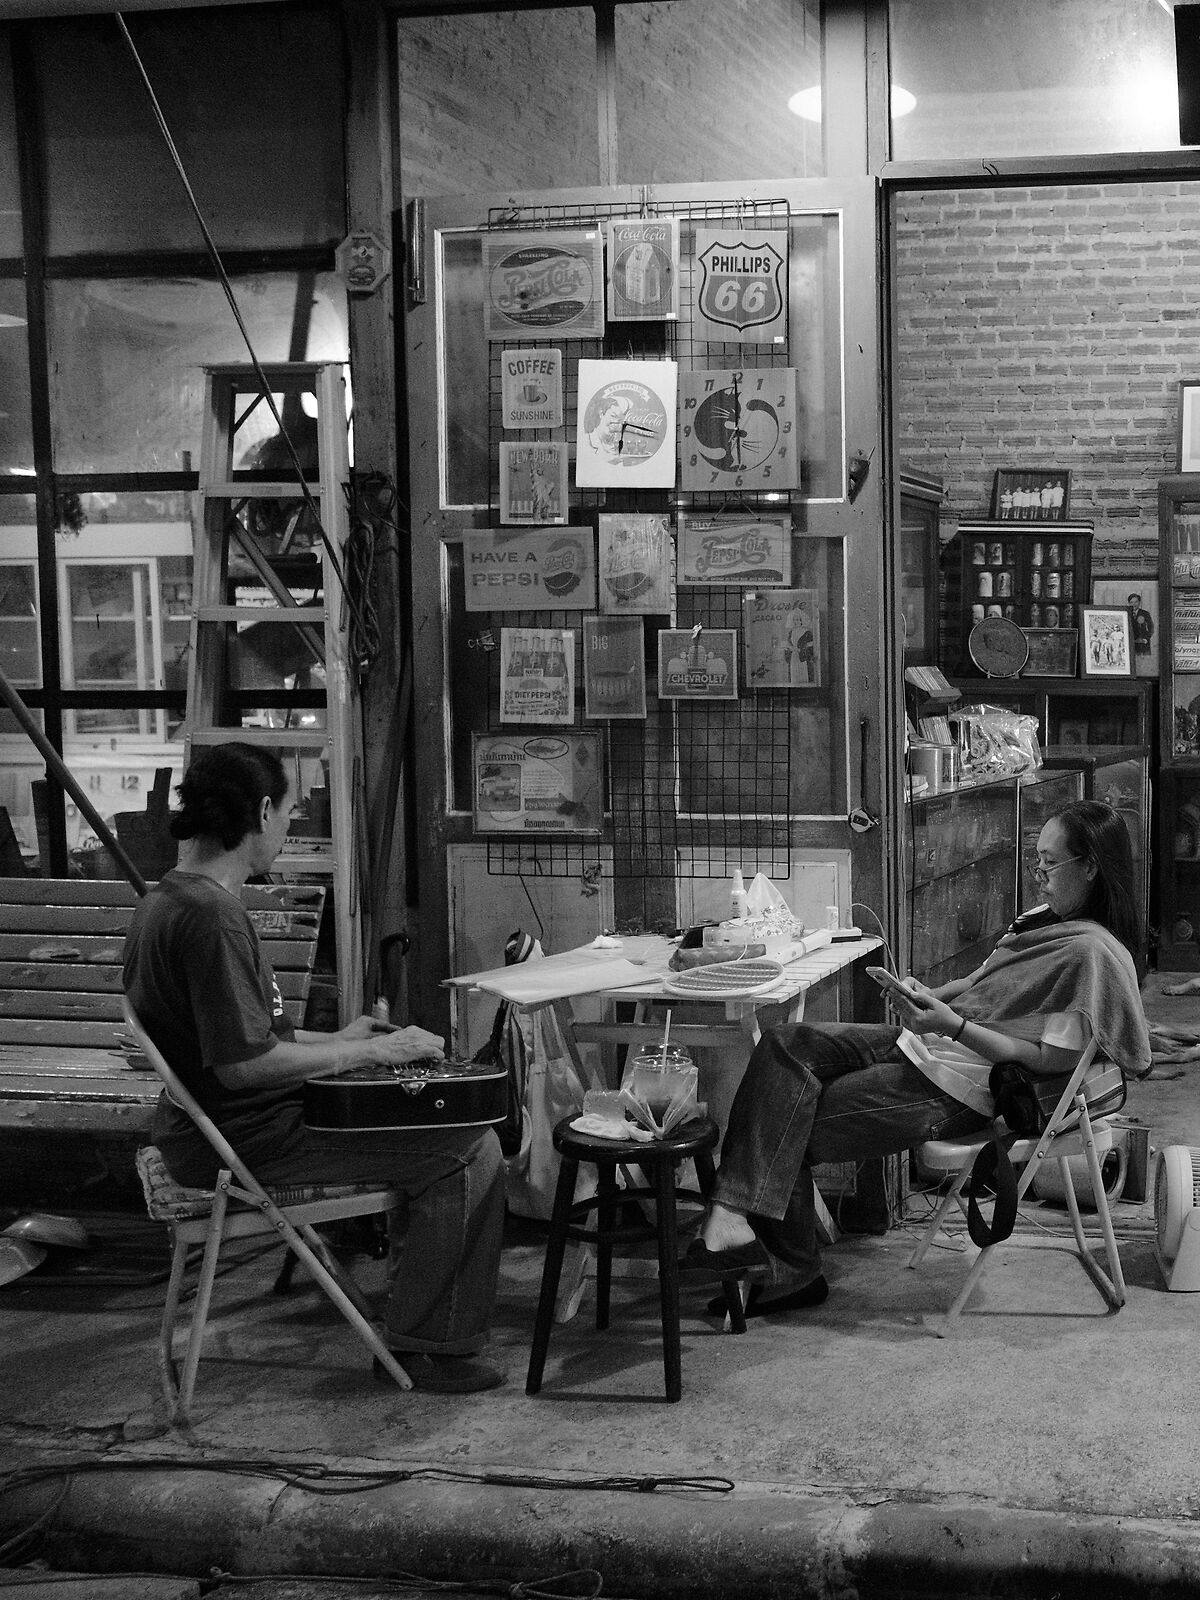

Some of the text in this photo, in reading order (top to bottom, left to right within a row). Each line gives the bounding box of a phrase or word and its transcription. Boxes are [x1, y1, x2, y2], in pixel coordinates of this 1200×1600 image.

[712, 256, 771, 273] PHILLIPS
[714, 280, 768, 313] 66
[508, 359, 555, 376] COFFEE
[704, 379, 715, 391] 11
[757, 378, 764, 391] 1
[684, 398, 697, 409] 10
[777, 395, 786, 408] 2
[510, 410, 554, 421] SUNSHINE
[683, 425, 692, 437] 9
[782, 421, 792, 434] 3
[778, 447, 787, 458] 4
[690, 454, 698, 467] 8
[710, 471, 719, 483] 7
[762, 465, 772, 478] 5
[735, 475, 743, 487] 6
[471, 551, 538, 563] HAVE A
[472, 572, 539, 587] PEPSI
[592, 635, 609, 650] BIG
[671, 674, 724, 684] CHEVROLET
[515, 691, 551, 699] DIET PEPSI
